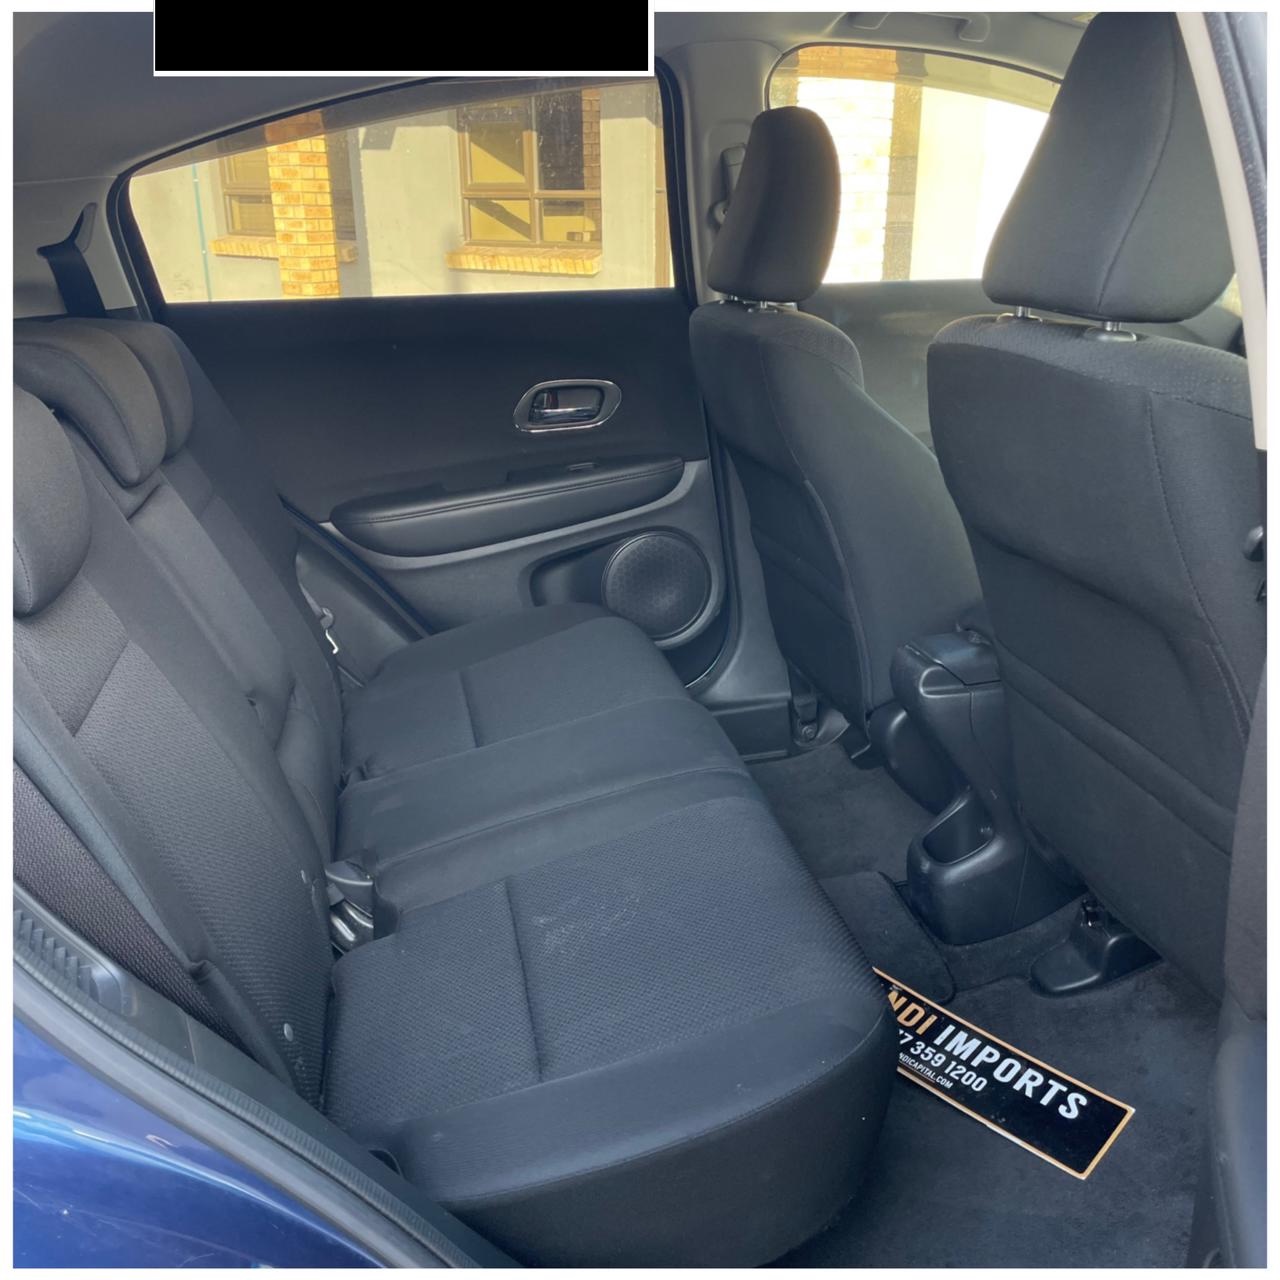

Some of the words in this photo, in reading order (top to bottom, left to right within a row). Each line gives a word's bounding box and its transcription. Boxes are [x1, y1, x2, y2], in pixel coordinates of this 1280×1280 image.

[910, 1039, 946, 1067] 359
[947, 1059, 988, 1092] 1200
[933, 1024, 1087, 1119] IMPORTS
